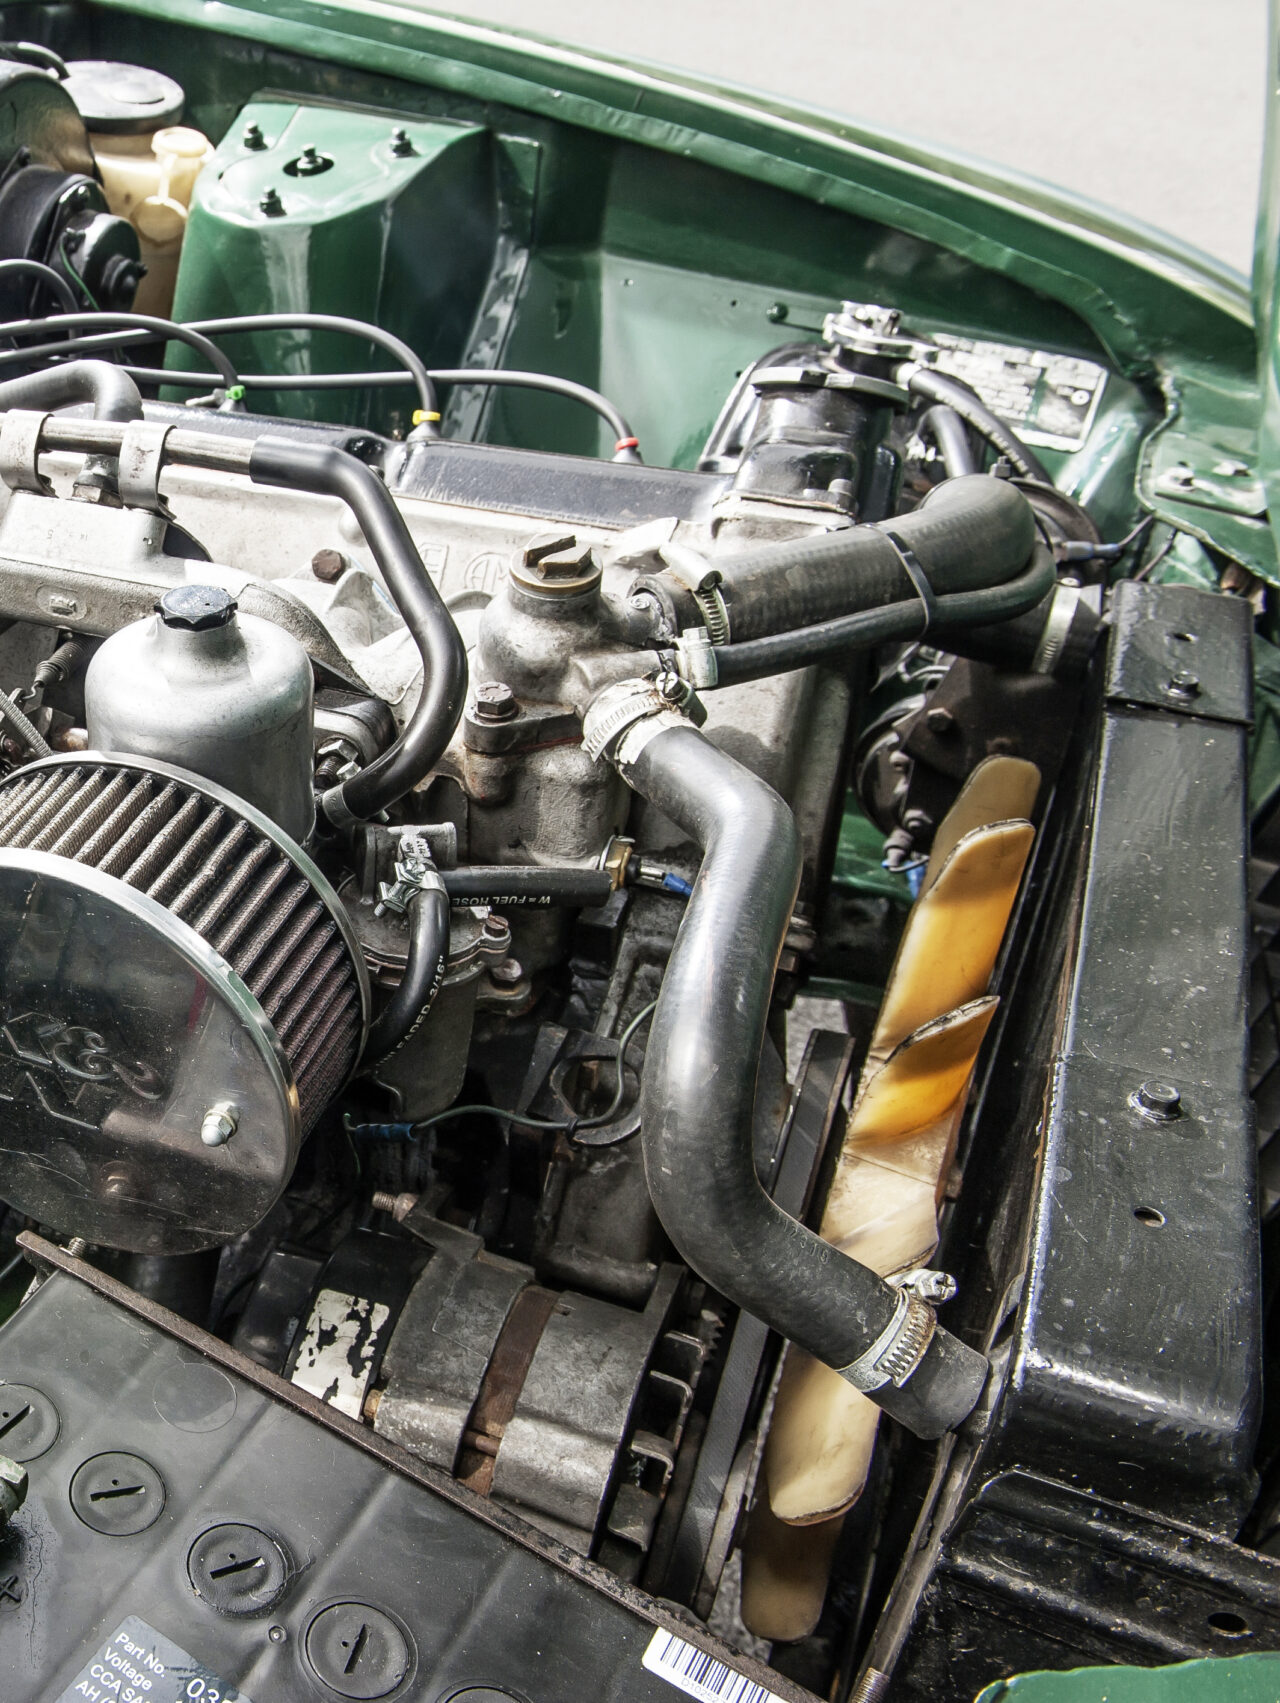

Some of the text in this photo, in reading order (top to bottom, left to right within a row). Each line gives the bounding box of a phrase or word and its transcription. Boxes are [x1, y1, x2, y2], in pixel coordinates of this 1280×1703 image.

[452, 897, 489, 906] HOSE
[492, 896, 525, 905] FUEL
[104, 1646, 153, 1691] Voltage
[115, 1632, 233, 1703] Part No. 03
[74, 1680, 102, 1702] AH
[90, 1663, 151, 1703] CCA SA
[680, 1677, 727, 1703] D10252
